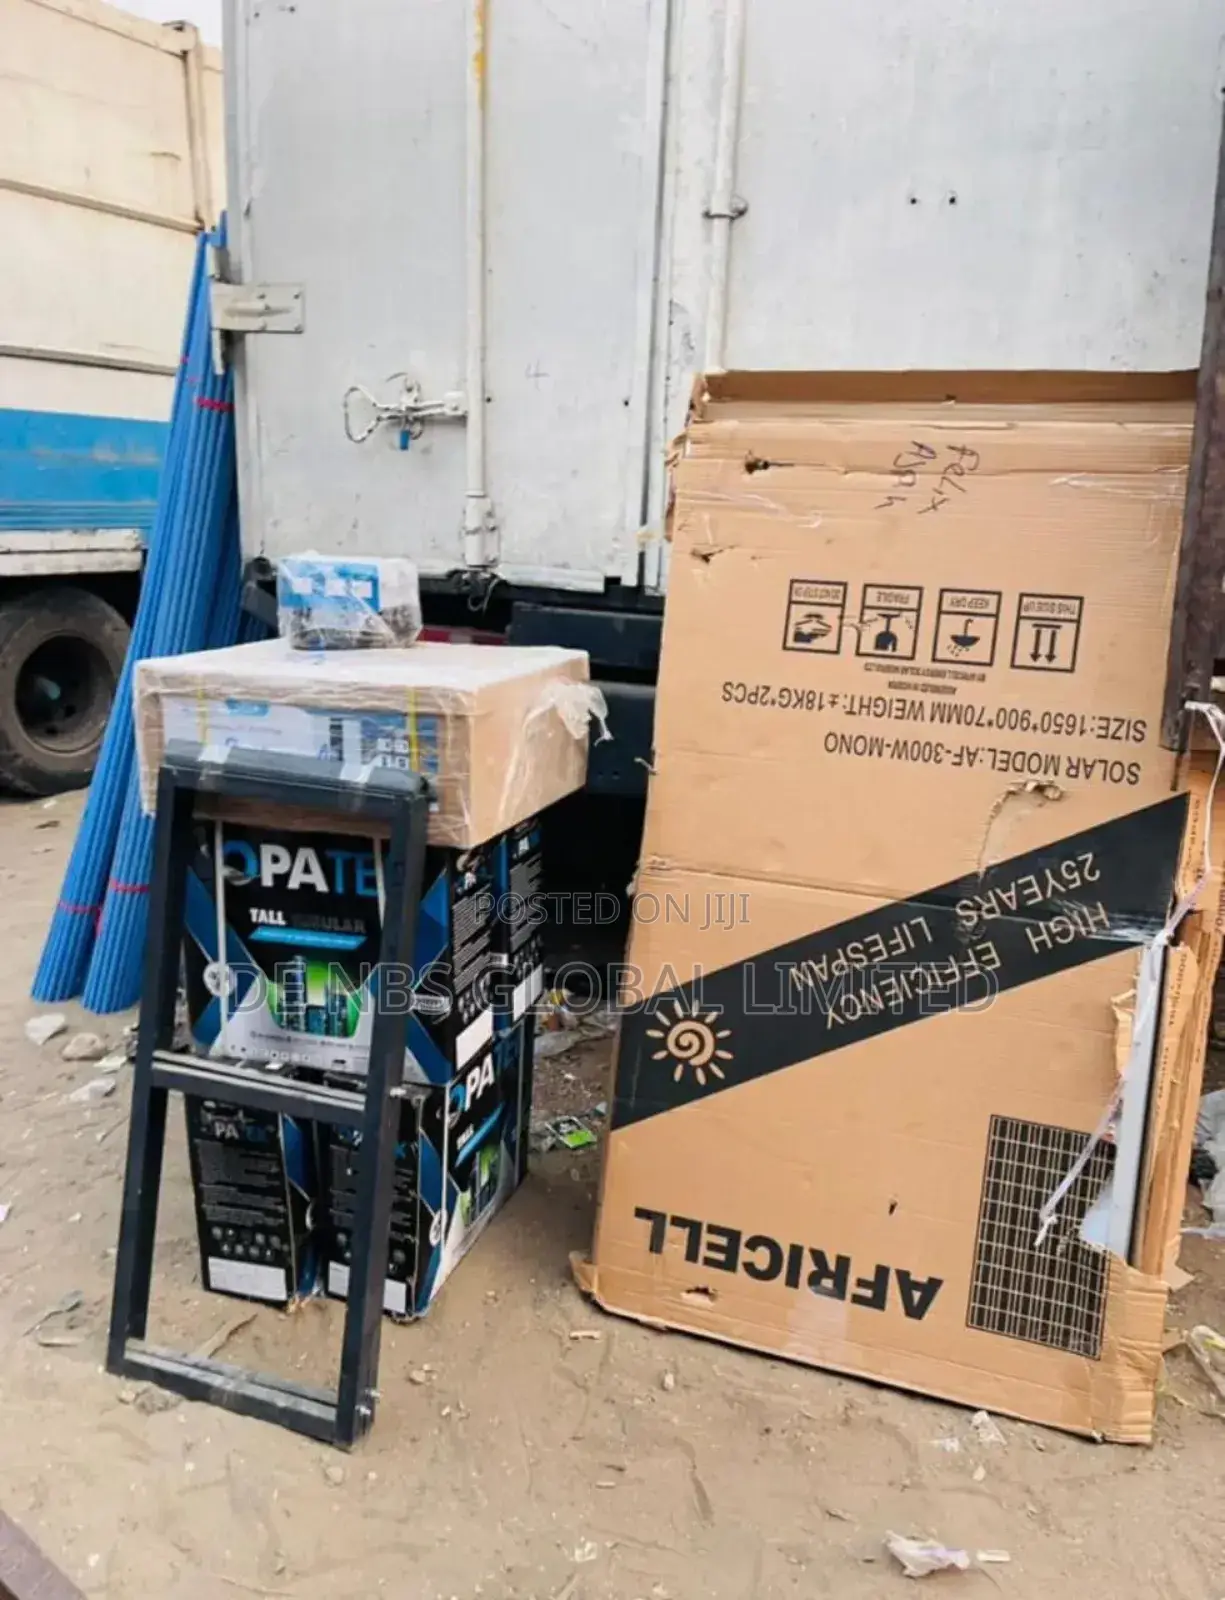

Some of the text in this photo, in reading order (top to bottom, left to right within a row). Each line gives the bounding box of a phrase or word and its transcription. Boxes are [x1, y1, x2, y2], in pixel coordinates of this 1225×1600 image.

[1065, 755, 1142, 786] SOLAR
[248, 906, 288, 926] TALL
[791, 916, 933, 992] LIFESPAN
[826, 901, 1111, 1030] HIGH EFFICIENCY
[634, 1205, 945, 1321] AFRICELL
